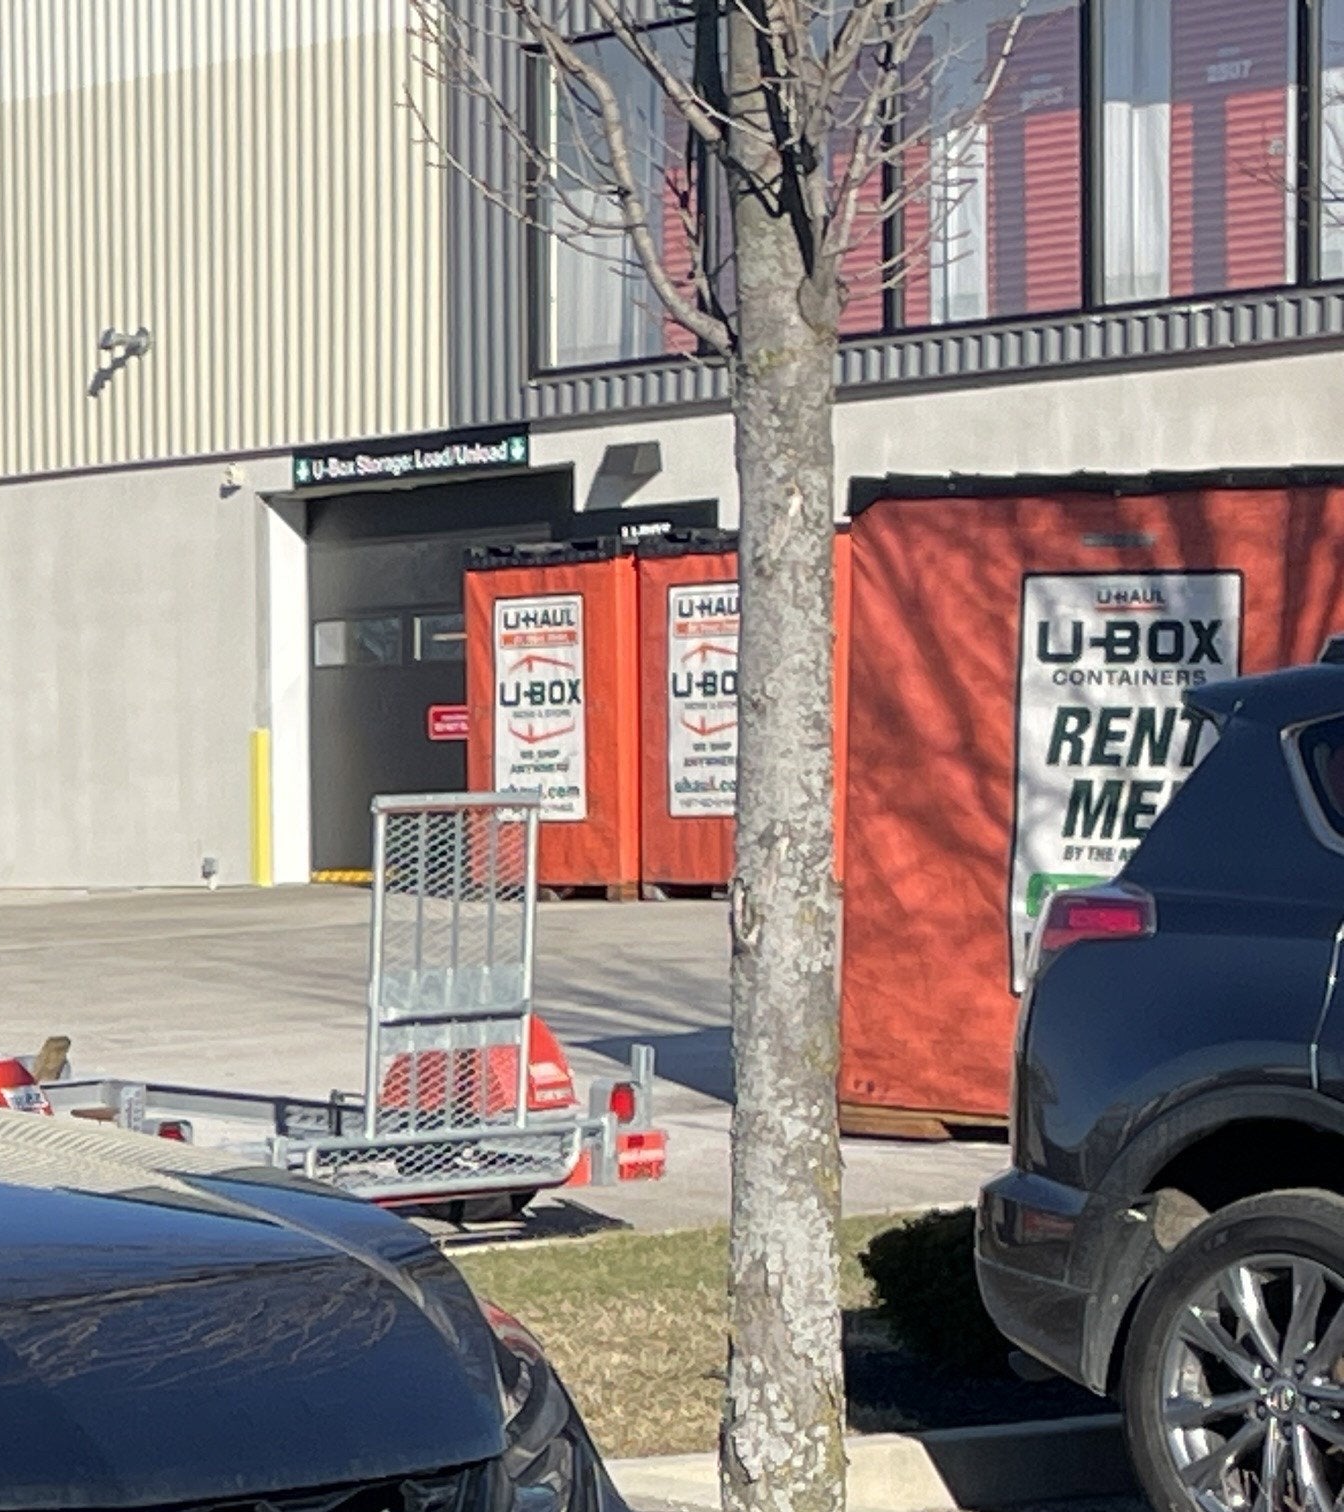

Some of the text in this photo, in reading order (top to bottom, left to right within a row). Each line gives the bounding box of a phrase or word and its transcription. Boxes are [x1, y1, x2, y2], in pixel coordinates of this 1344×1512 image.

[312, 457, 354, 480] U-Box
[678, 597, 740, 618] U-HAU
[1097, 590, 1166, 605] U-HAUL
[503, 609, 575, 630] U-HAUL
[1037, 620, 1222, 664] U-BOX
[672, 670, 738, 698] U-BO
[1052, 669, 1207, 686] CONTAINERS
[500, 679, 581, 707] U-BOX
[1046, 707, 1216, 766] RENT
[1062, 779, 1184, 839] ME
